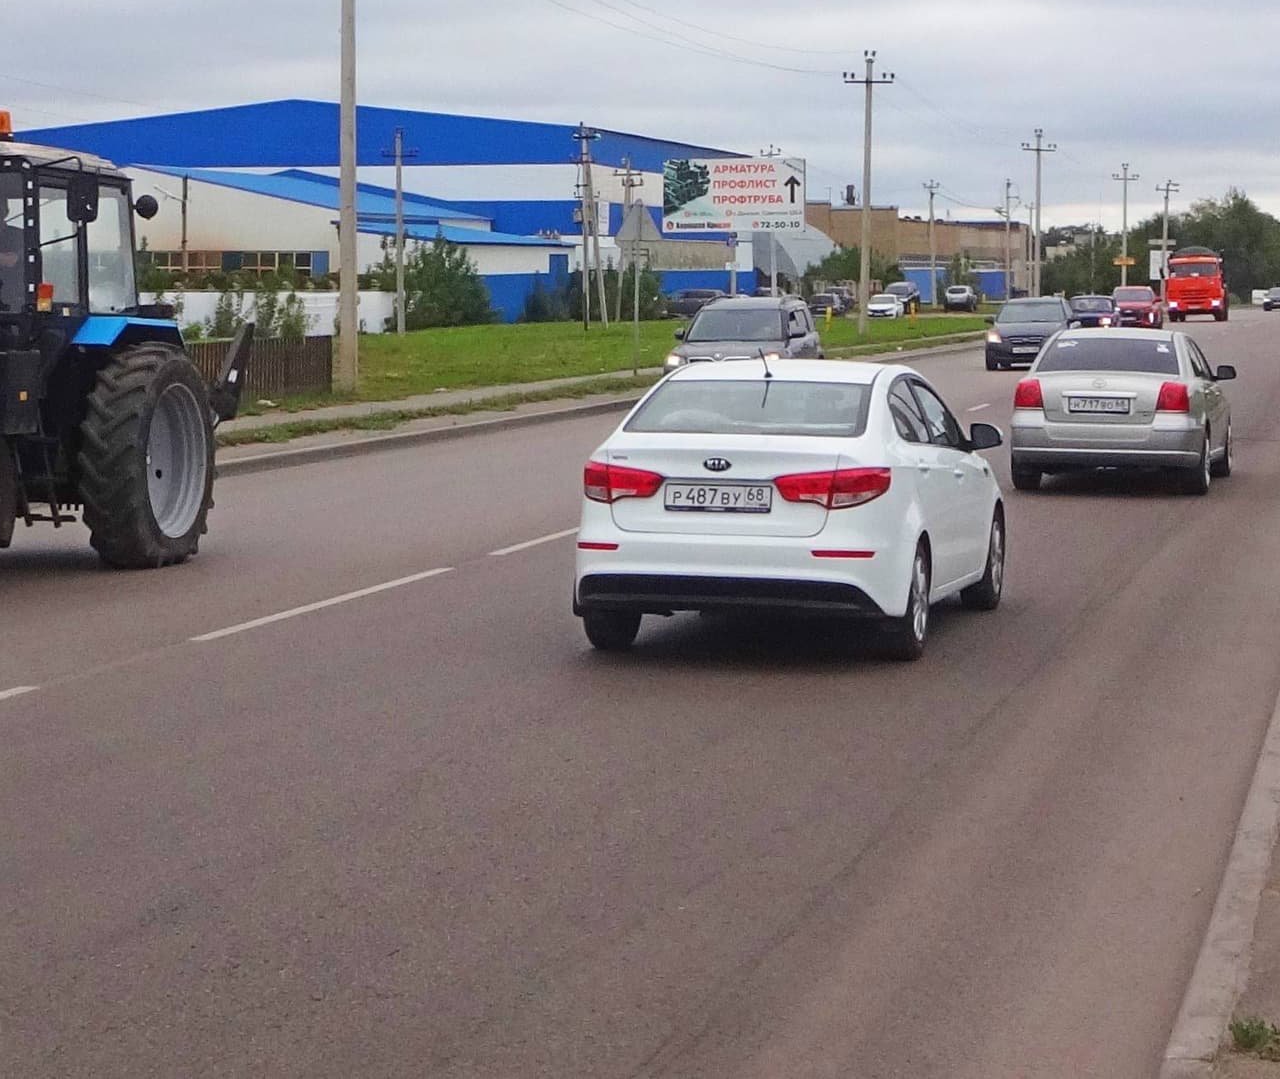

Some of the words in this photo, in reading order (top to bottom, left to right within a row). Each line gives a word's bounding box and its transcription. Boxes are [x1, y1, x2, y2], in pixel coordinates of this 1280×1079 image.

[713, 164, 775, 174] АРМАТУРА
[713, 179, 778, 189] ПРОФЛИСТ
[712, 195, 784, 205] ПРОФТРУБА
[760, 221, 801, 229] 72-50-10
[706, 460, 728, 470] KIA
[747, 488, 764, 501] 68
